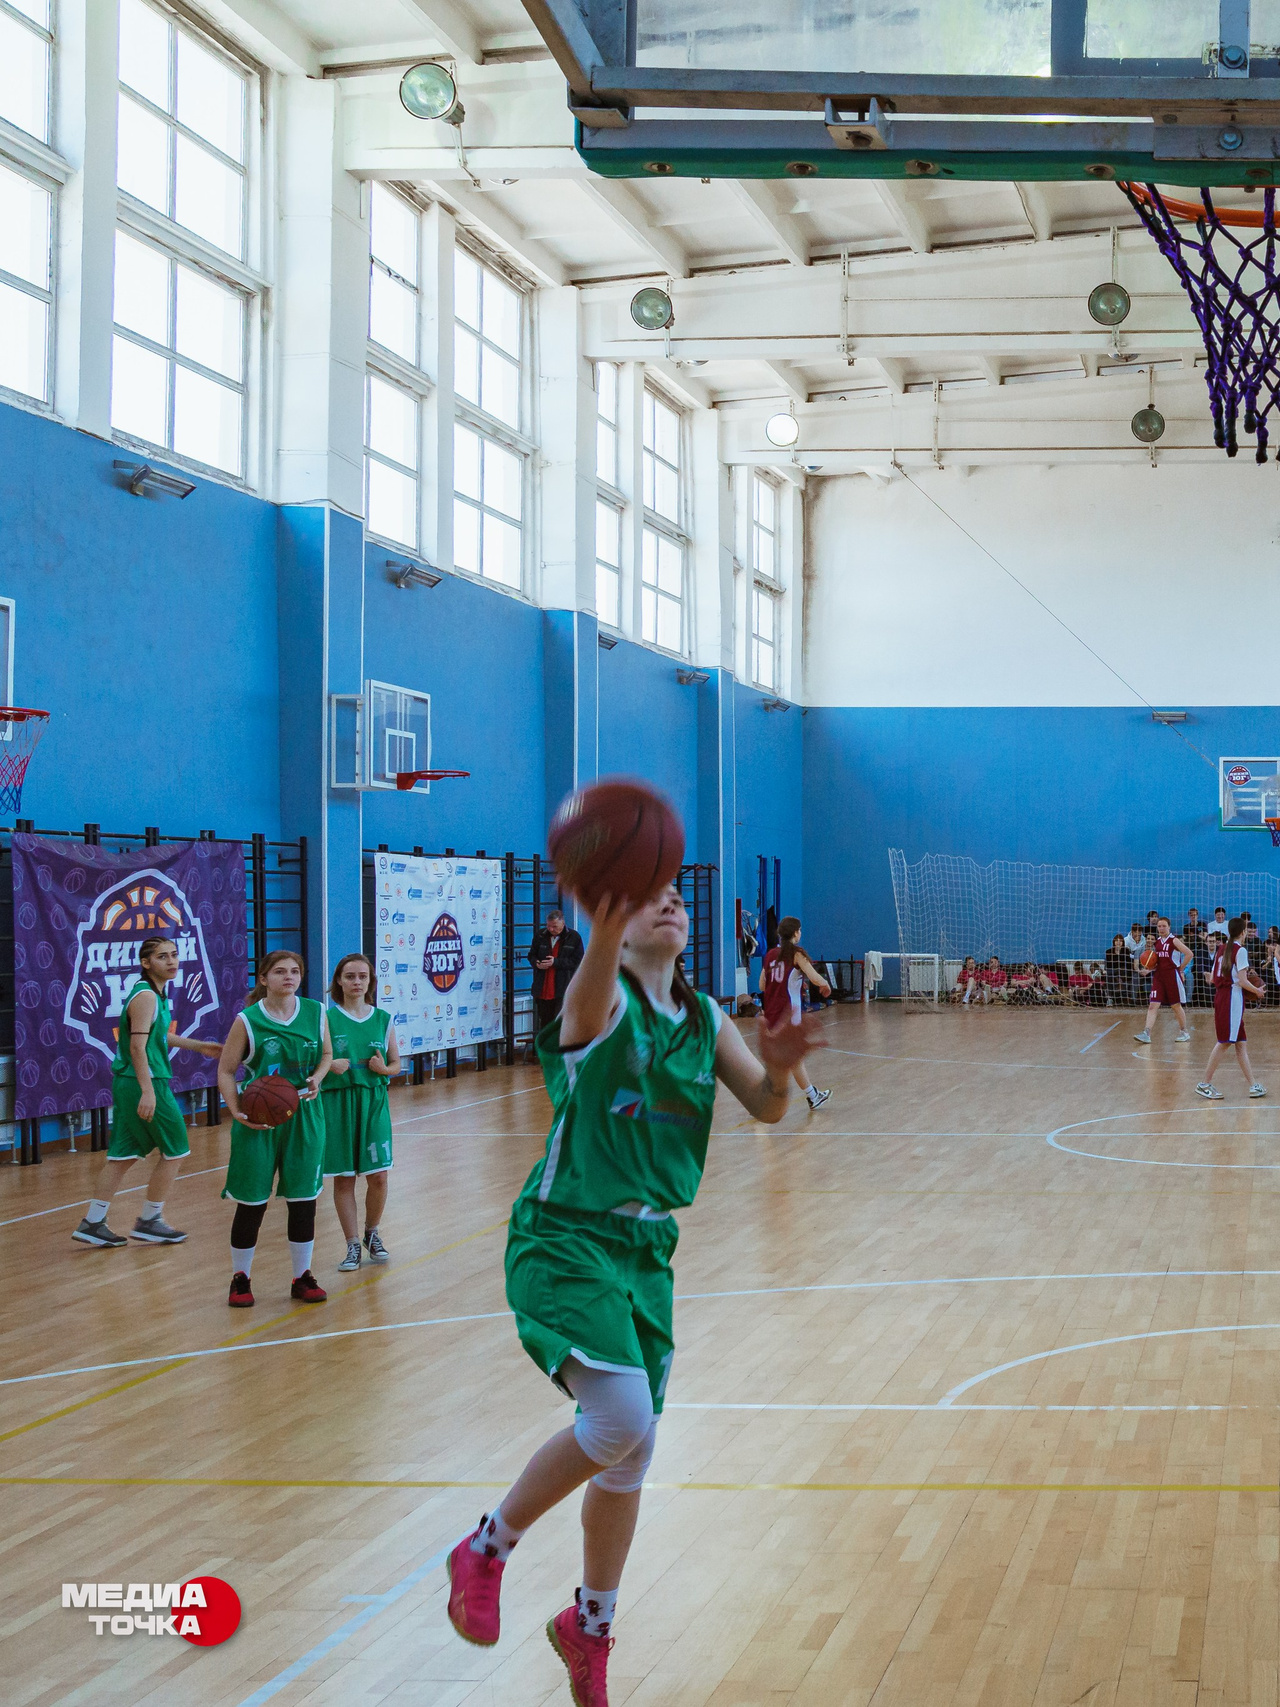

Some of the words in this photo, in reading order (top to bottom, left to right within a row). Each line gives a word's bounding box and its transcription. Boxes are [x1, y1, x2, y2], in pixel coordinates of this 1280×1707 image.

[426, 937, 460, 954] ДИКИЙ
[432, 953, 458, 972] ЮГ
[770, 960, 785, 983] 10
[367, 1140, 391, 1163] 11
